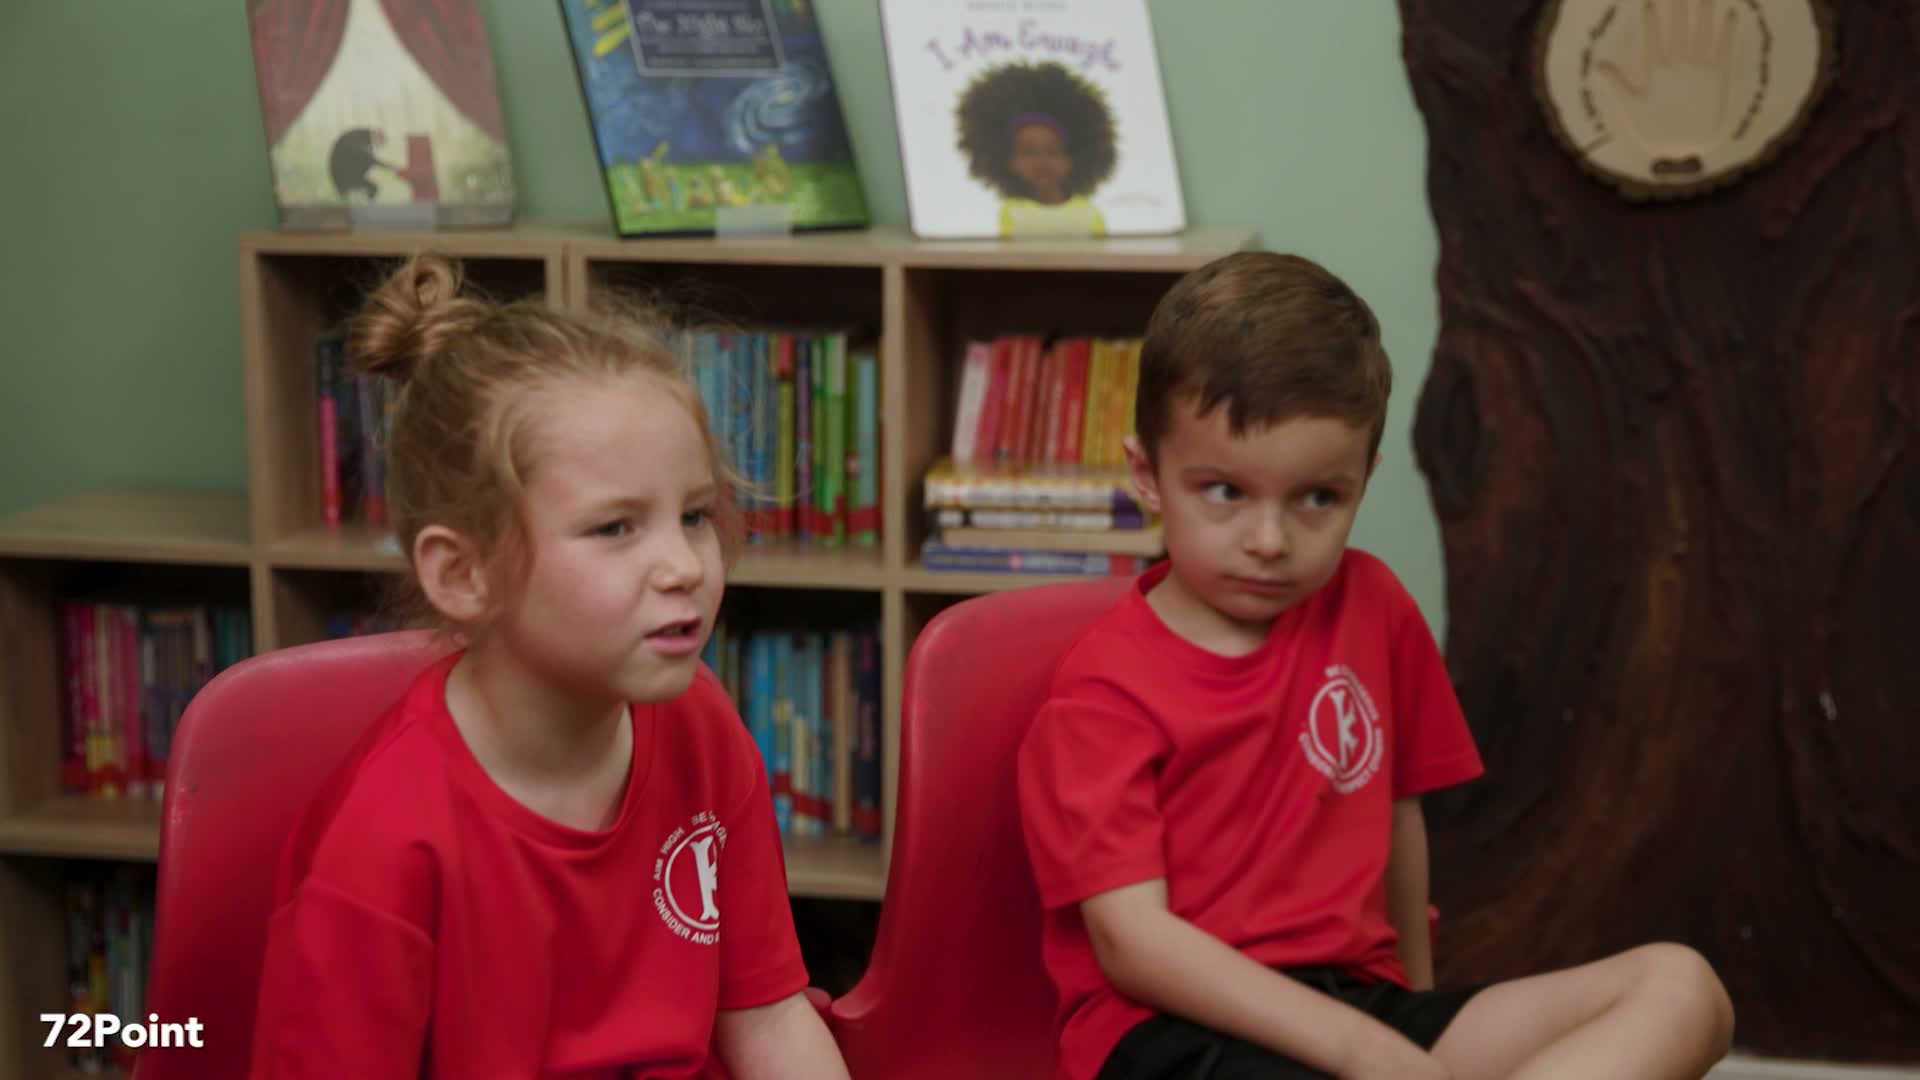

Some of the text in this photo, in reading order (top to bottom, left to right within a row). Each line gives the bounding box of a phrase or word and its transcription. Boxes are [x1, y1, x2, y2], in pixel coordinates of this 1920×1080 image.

[955, 25, 1013, 57] Am
[659, 826, 685, 855] HIGH
[652, 887, 714, 946] CONSIDER AND
